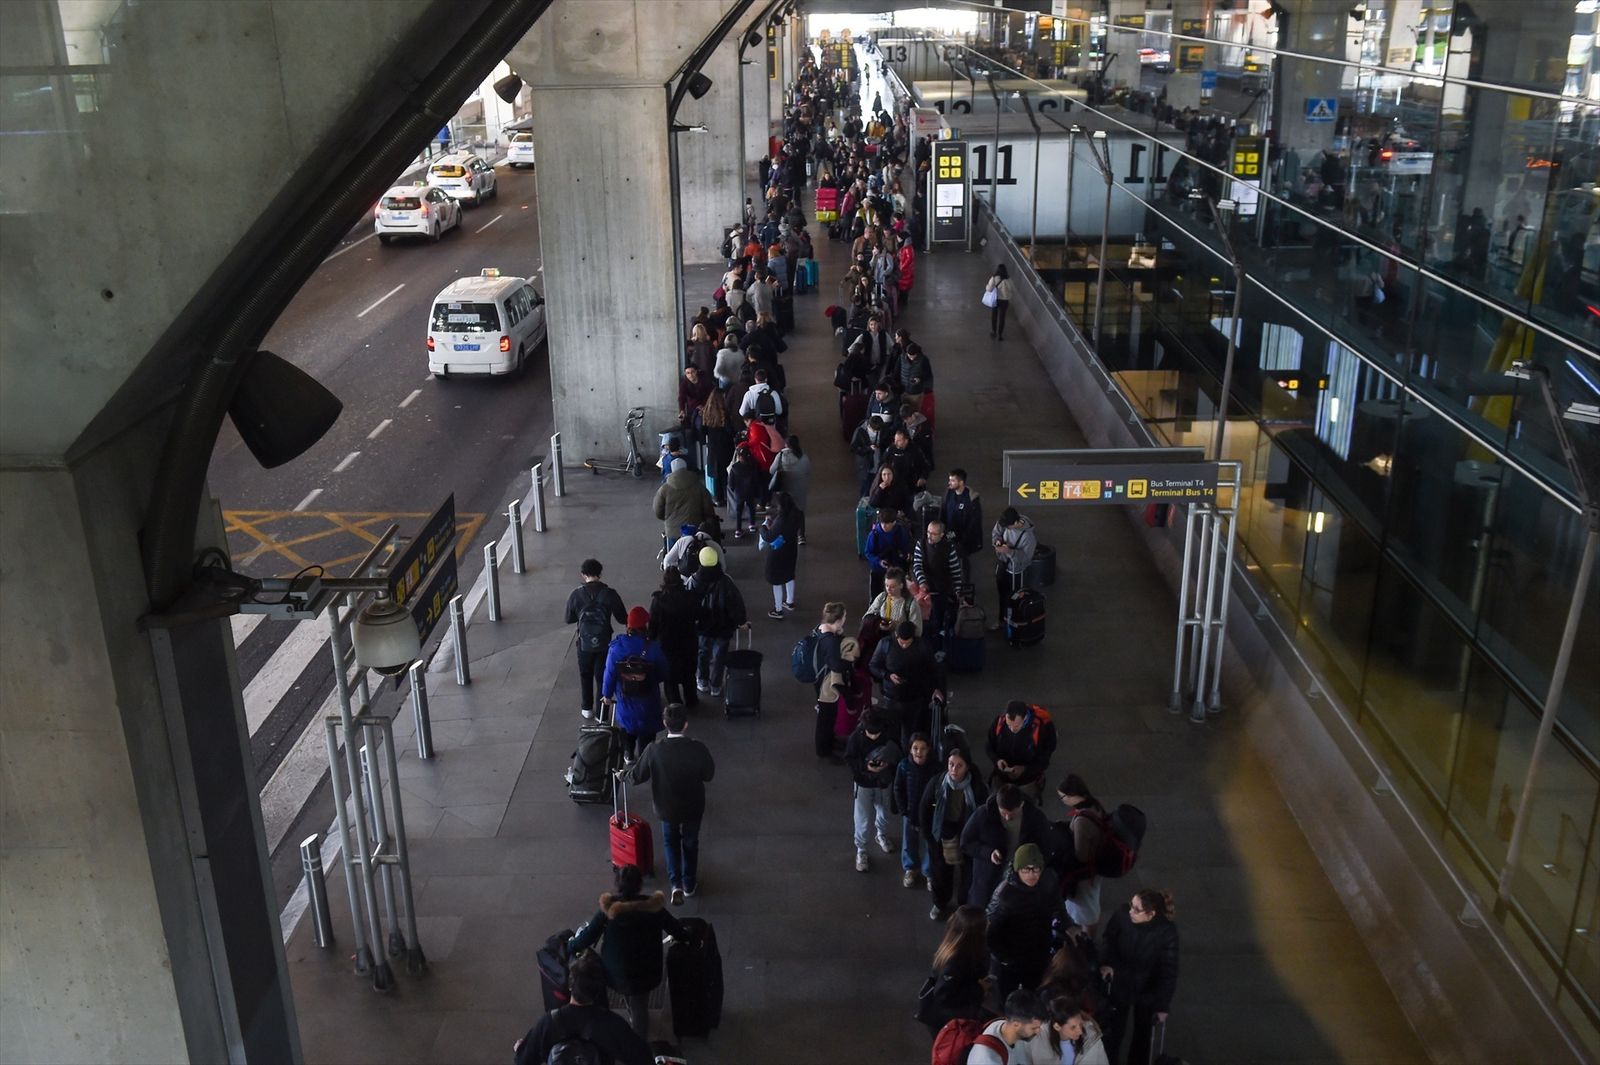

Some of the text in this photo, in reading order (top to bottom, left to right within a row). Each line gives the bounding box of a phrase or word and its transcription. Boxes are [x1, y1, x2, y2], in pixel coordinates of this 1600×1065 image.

[886, 46, 907, 62] 13
[972, 144, 1017, 185] 11
[1064, 484, 1081, 497] T4
[1151, 489, 1183, 497] Terminal
[1203, 488, 1213, 496] T4
